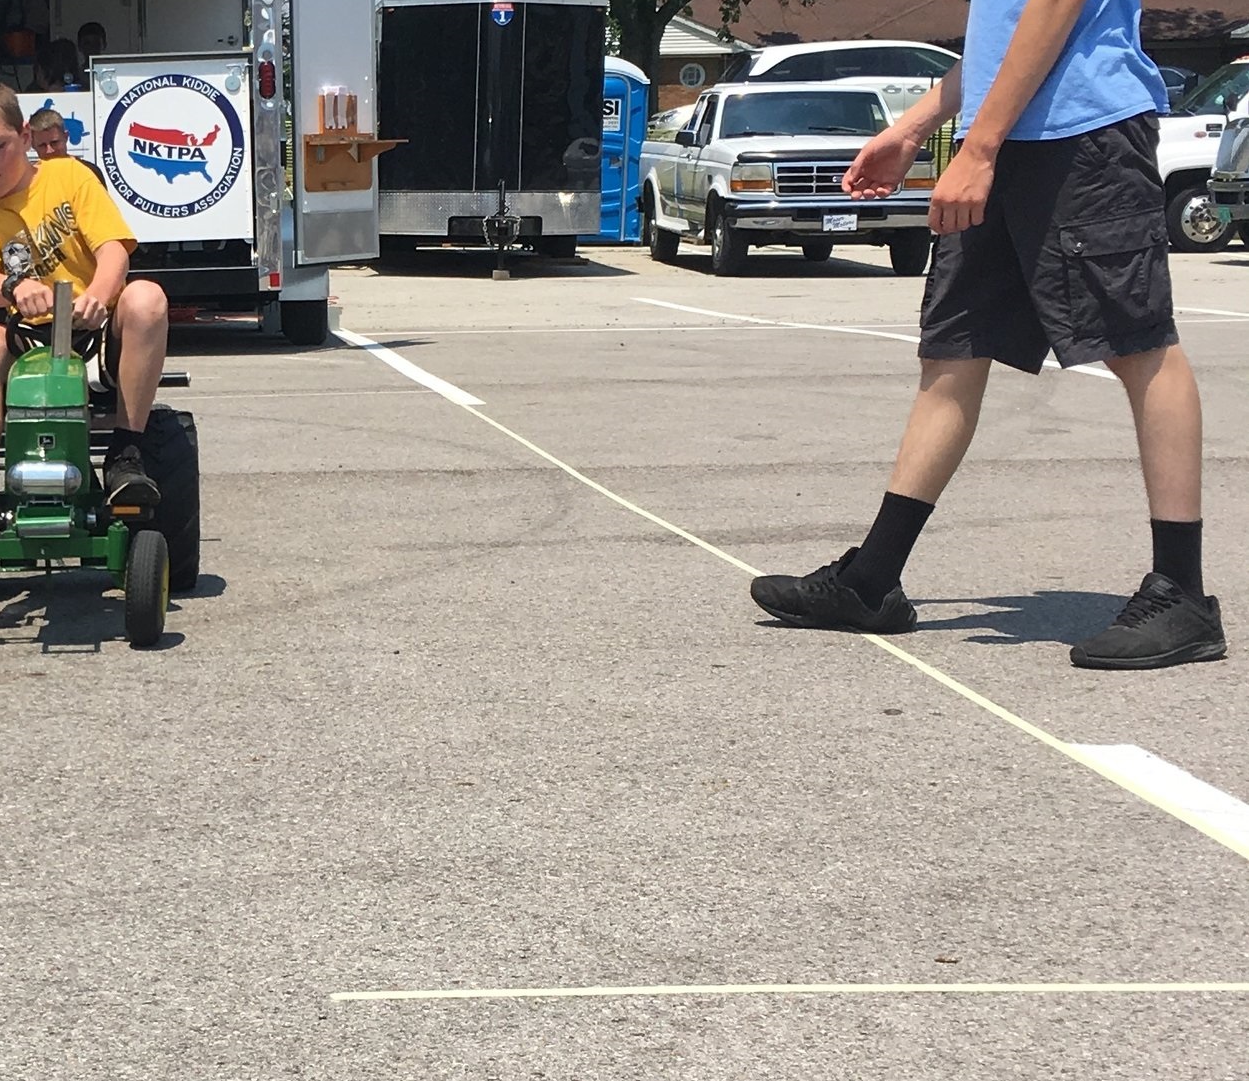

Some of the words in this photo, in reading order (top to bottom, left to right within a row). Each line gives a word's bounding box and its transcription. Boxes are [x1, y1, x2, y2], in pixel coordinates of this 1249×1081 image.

[120, 76, 177, 107] NATIONAL
[182, 77, 220, 101] KIDDIE
[133, 138, 207, 160] NKTPA
[104, 147, 134, 200] TRACTOR
[134, 198, 189, 217] PULLERS
[194, 147, 243, 213] ASSOCIATION
